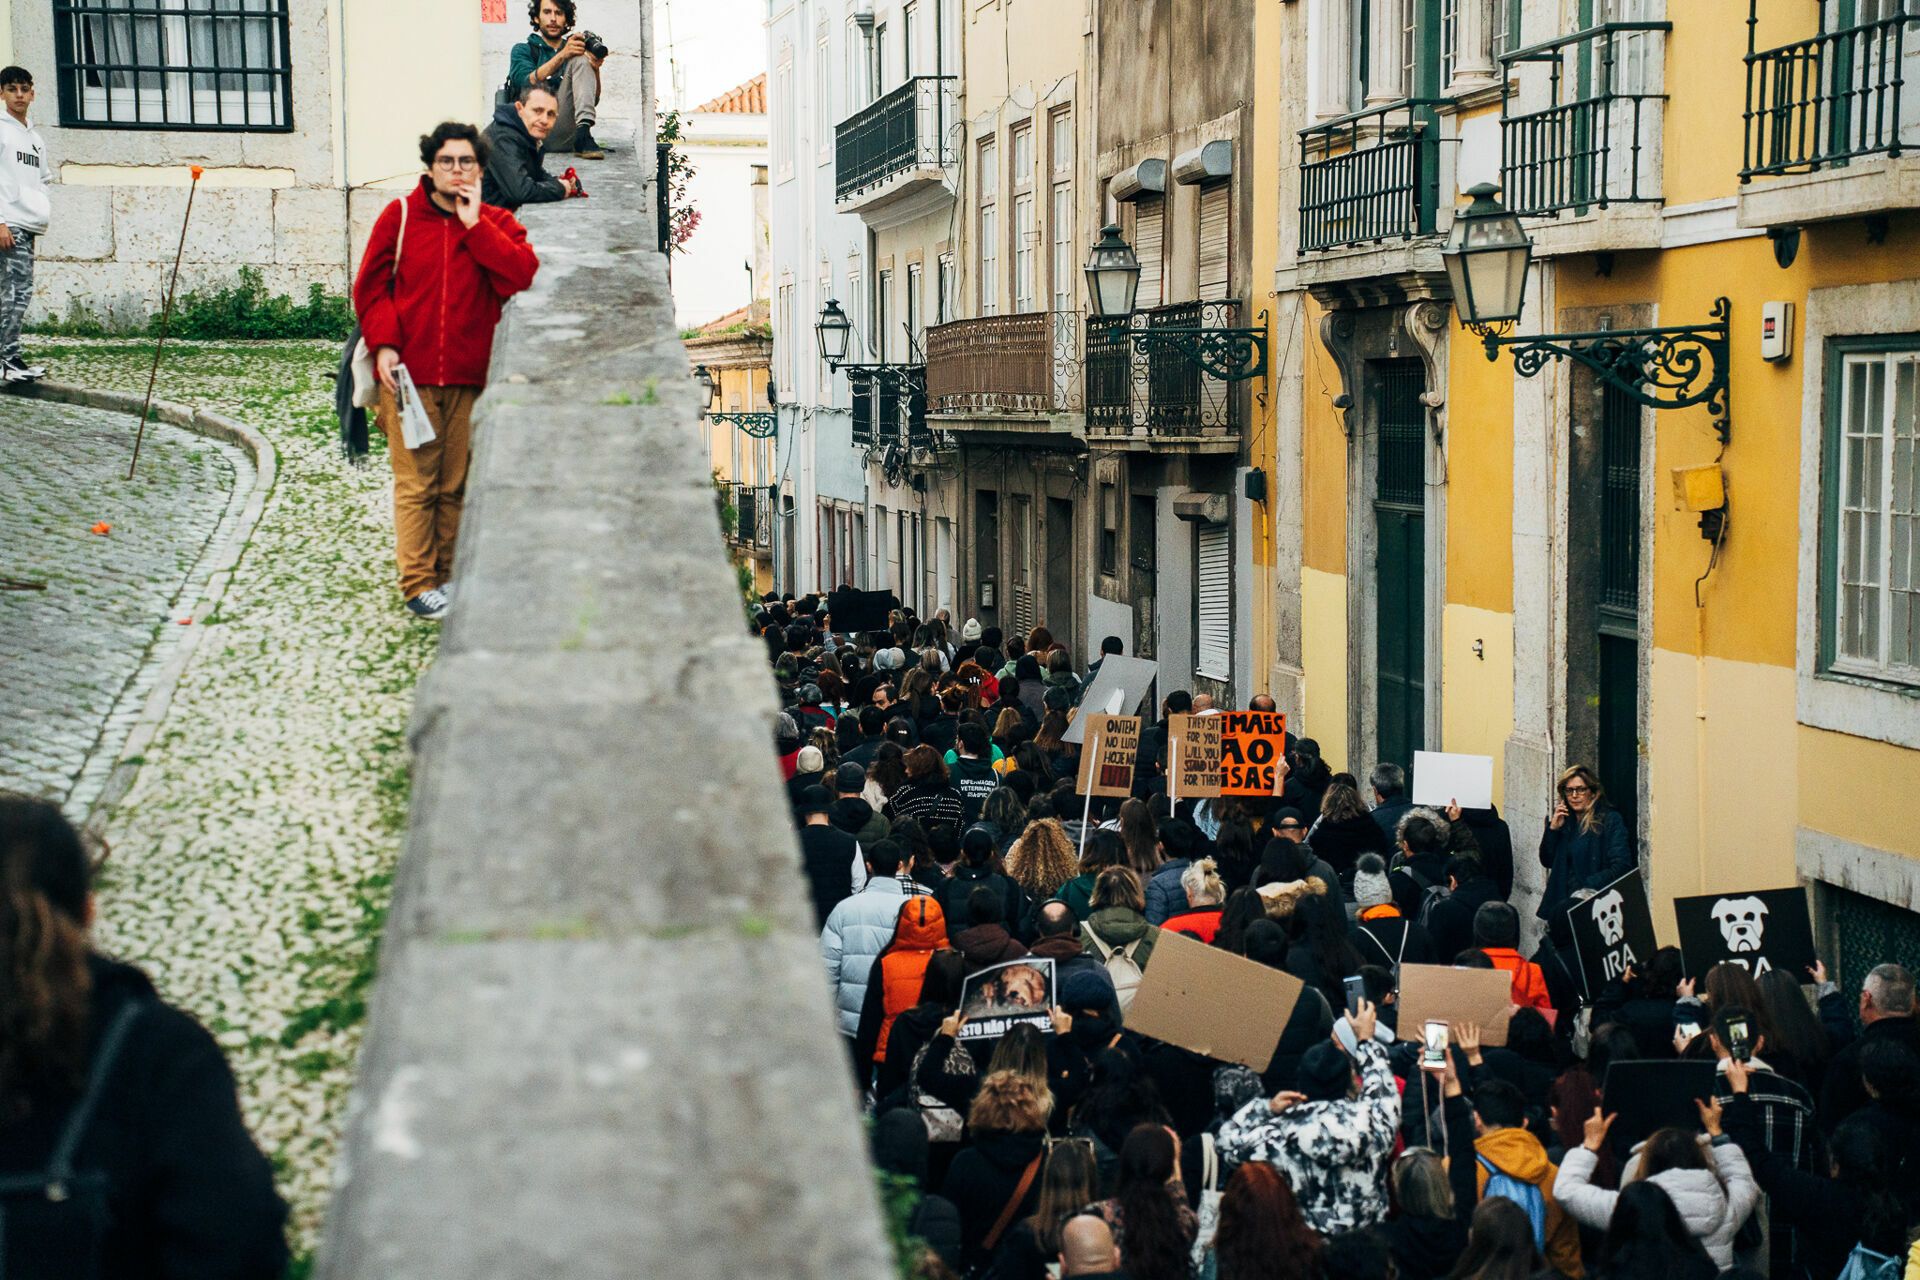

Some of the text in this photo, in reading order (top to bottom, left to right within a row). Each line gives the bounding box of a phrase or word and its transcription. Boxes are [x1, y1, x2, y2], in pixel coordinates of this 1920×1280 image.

[16, 151, 40, 169] PUMA
[1106, 719, 1137, 735] ONTEM
[1187, 716, 1220, 731] THEY SIT
[1105, 736, 1138, 749] NO LUTO
[1186, 731, 1220, 745] FOR YOU
[1103, 751, 1126, 765] HOJE
[1184, 745, 1220, 760] WILL YOU
[1183, 759, 1220, 773] STAND UP
[1183, 774, 1199, 786] FOR
[1602, 943, 1637, 982] IRA
[983, 1019, 1005, 1034] NÃO
